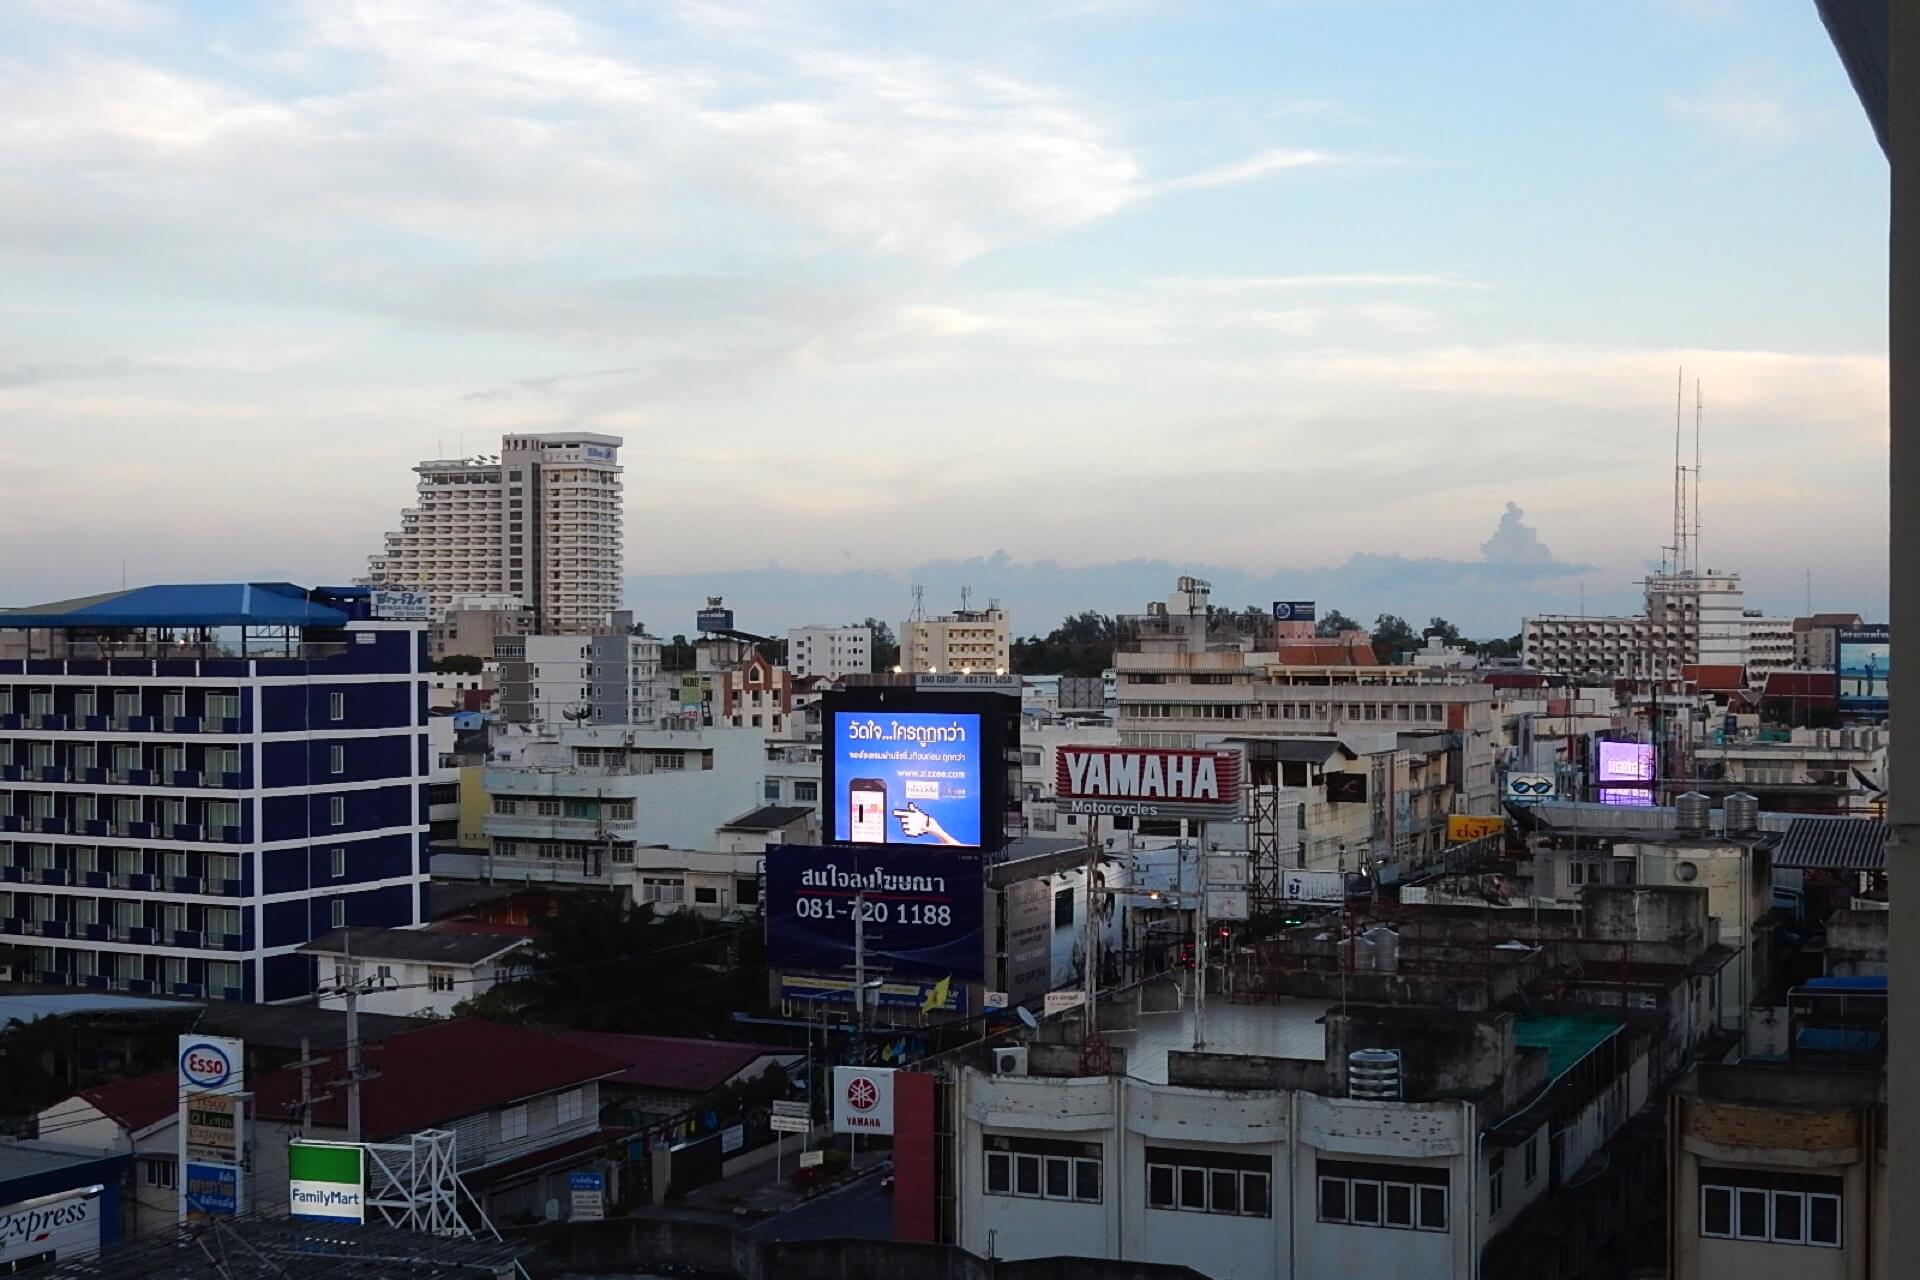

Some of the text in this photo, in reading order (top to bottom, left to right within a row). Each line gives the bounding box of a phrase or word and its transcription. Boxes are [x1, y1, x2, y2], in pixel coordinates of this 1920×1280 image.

[1064, 752, 1219, 799] YAMAHA
[1071, 800, 1159, 816] Motorcycles
[802, 864, 945, 893] สนใจลงโฆษณา
[796, 897, 952, 927] 081-720 1188
[847, 1116, 881, 1128] YAMAHA
[292, 1188, 360, 1206] FamilyMart
